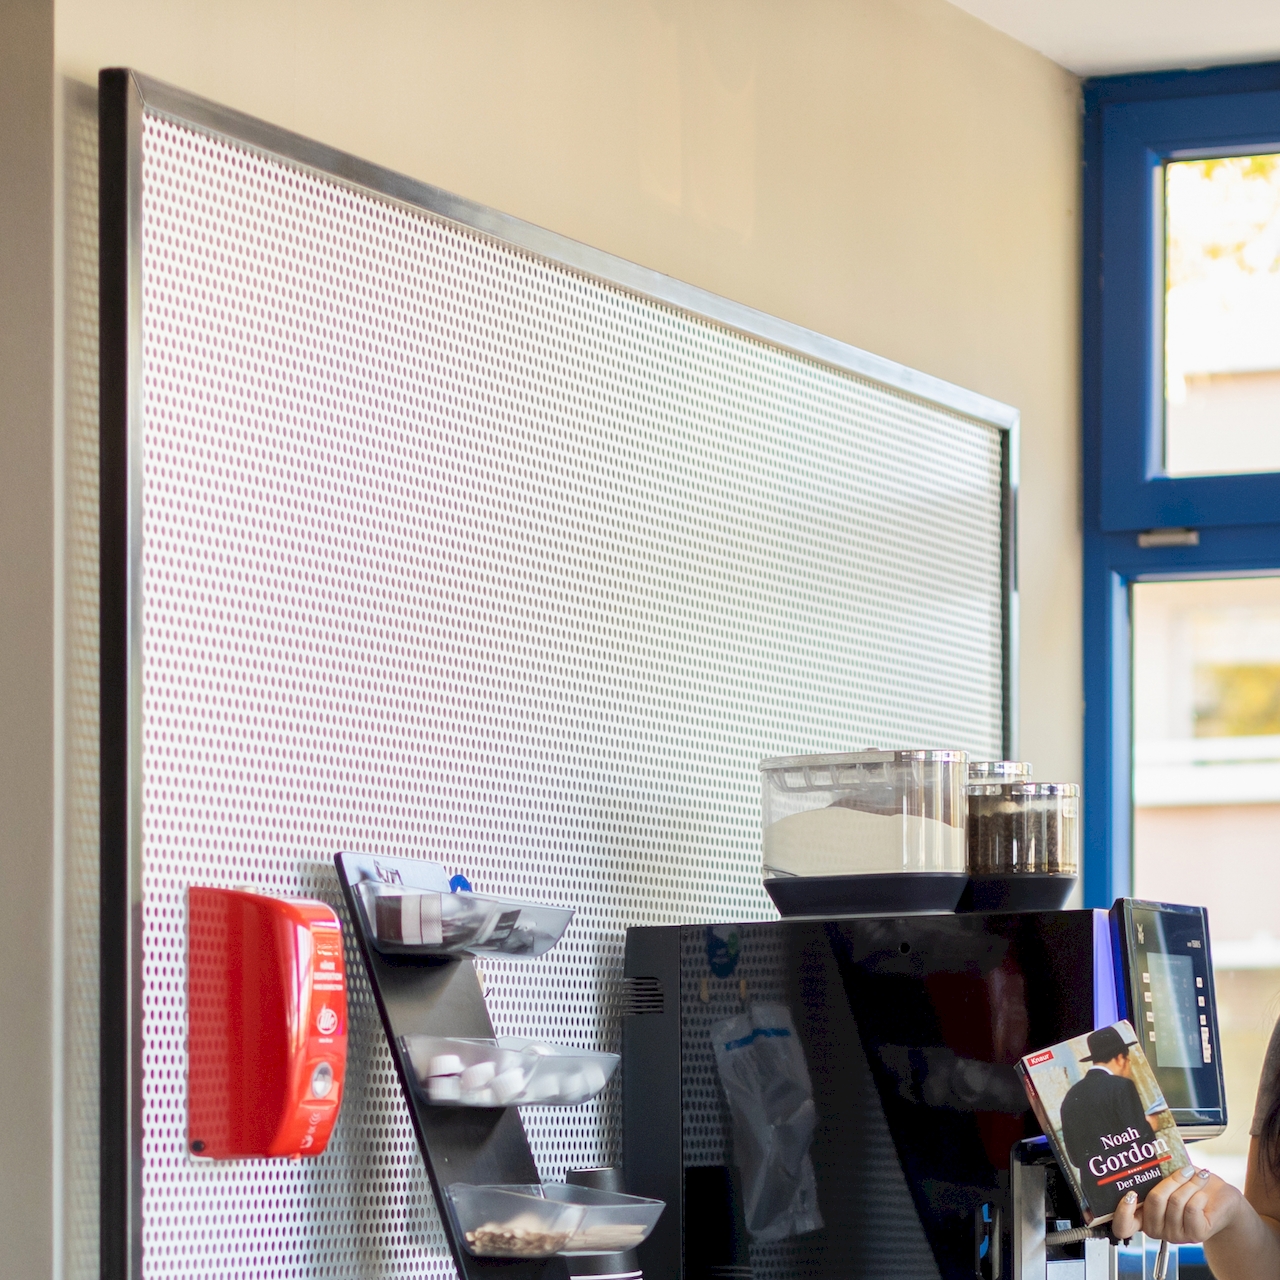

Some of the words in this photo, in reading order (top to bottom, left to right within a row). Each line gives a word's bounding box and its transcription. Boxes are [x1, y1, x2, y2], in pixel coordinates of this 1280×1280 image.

[1030, 1053, 1050, 1065] Knaur
[1100, 1126, 1140, 1150] Noah
[1089, 1138, 1170, 1177] Gordon
[1116, 1178, 1134, 1191] Der
[1135, 1167, 1161, 1184] Rabbi
[1127, 1166, 1142, 1174] Roman
